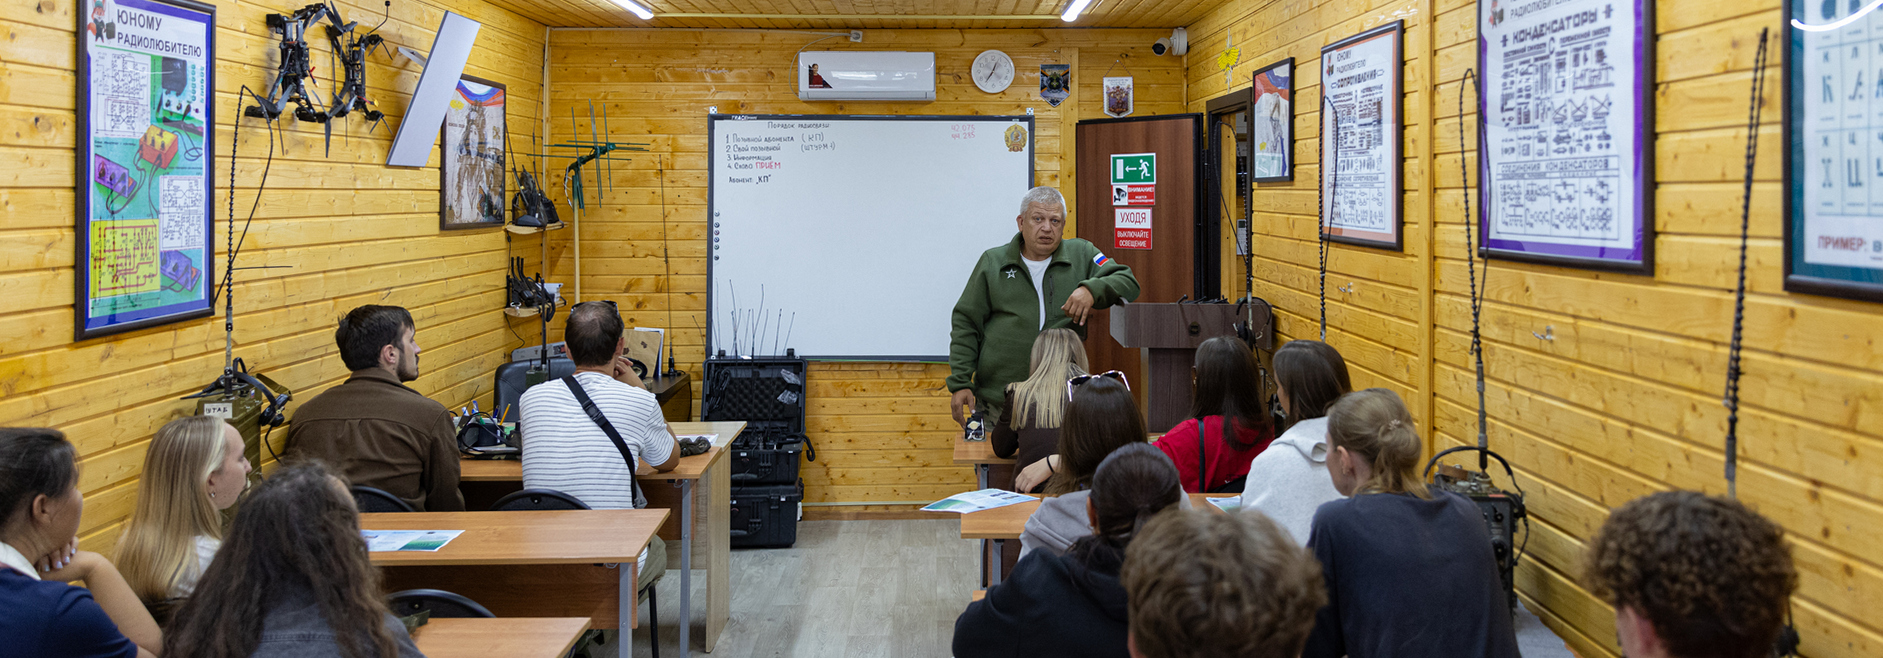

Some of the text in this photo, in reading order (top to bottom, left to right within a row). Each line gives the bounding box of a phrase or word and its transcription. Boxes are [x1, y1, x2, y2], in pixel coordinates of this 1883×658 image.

[117, 9, 162, 31] ЮНОМУ
[1512, 8, 1598, 45] КОНДЕНСАТОРЫ
[117, 32, 202, 57] РАДИОЛЮБИТЕЛЮ
[1120, 212, 1146, 224] УХОДЯ
[1117, 230, 1149, 238] ВЫКЛЮЧАЙТЕ
[1818, 236, 1867, 251] ПРИМЕР:
